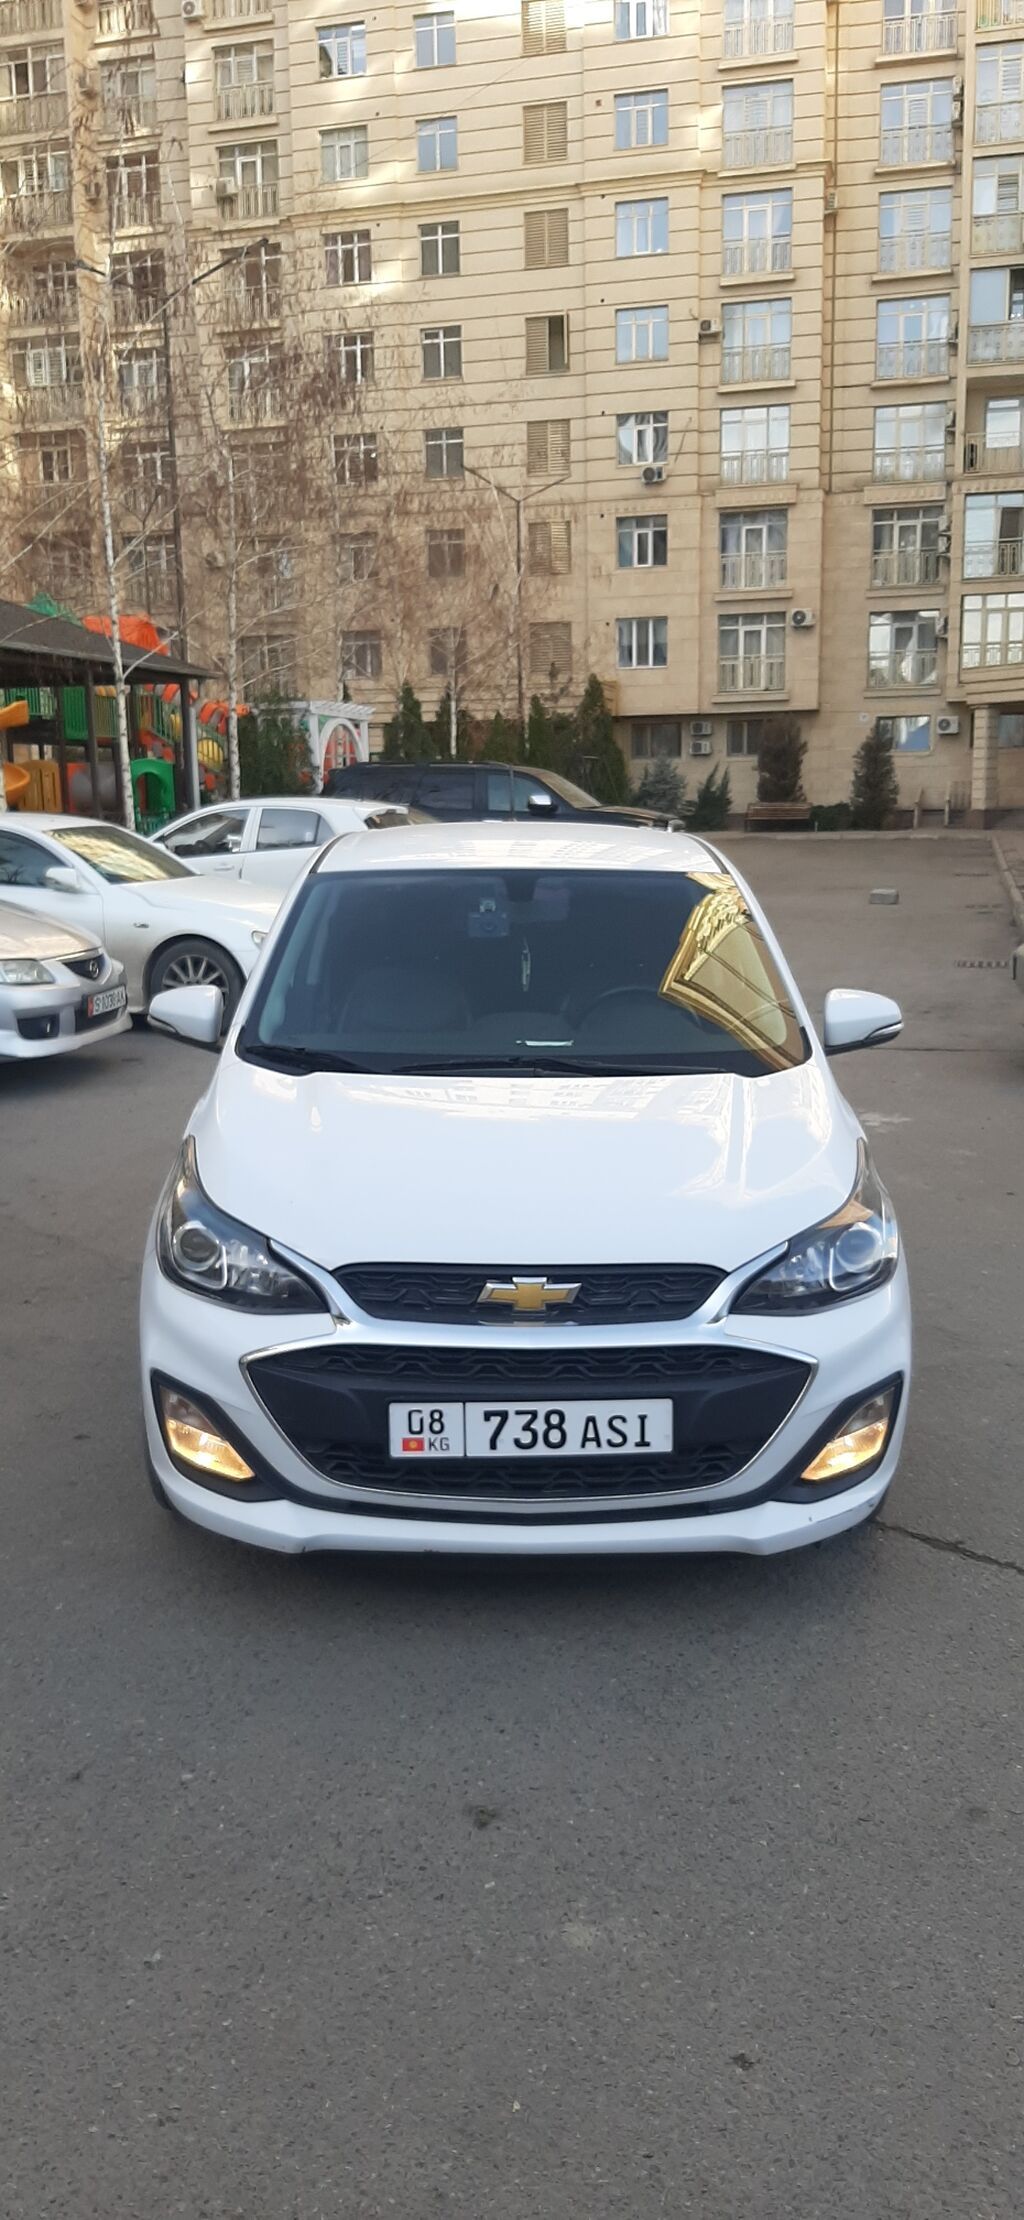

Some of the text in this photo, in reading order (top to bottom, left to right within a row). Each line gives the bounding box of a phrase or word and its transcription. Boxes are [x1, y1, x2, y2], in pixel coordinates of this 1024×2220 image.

[408, 1409, 651, 1450] 08 738 ASI
[428, 1437, 450, 1451] KG
